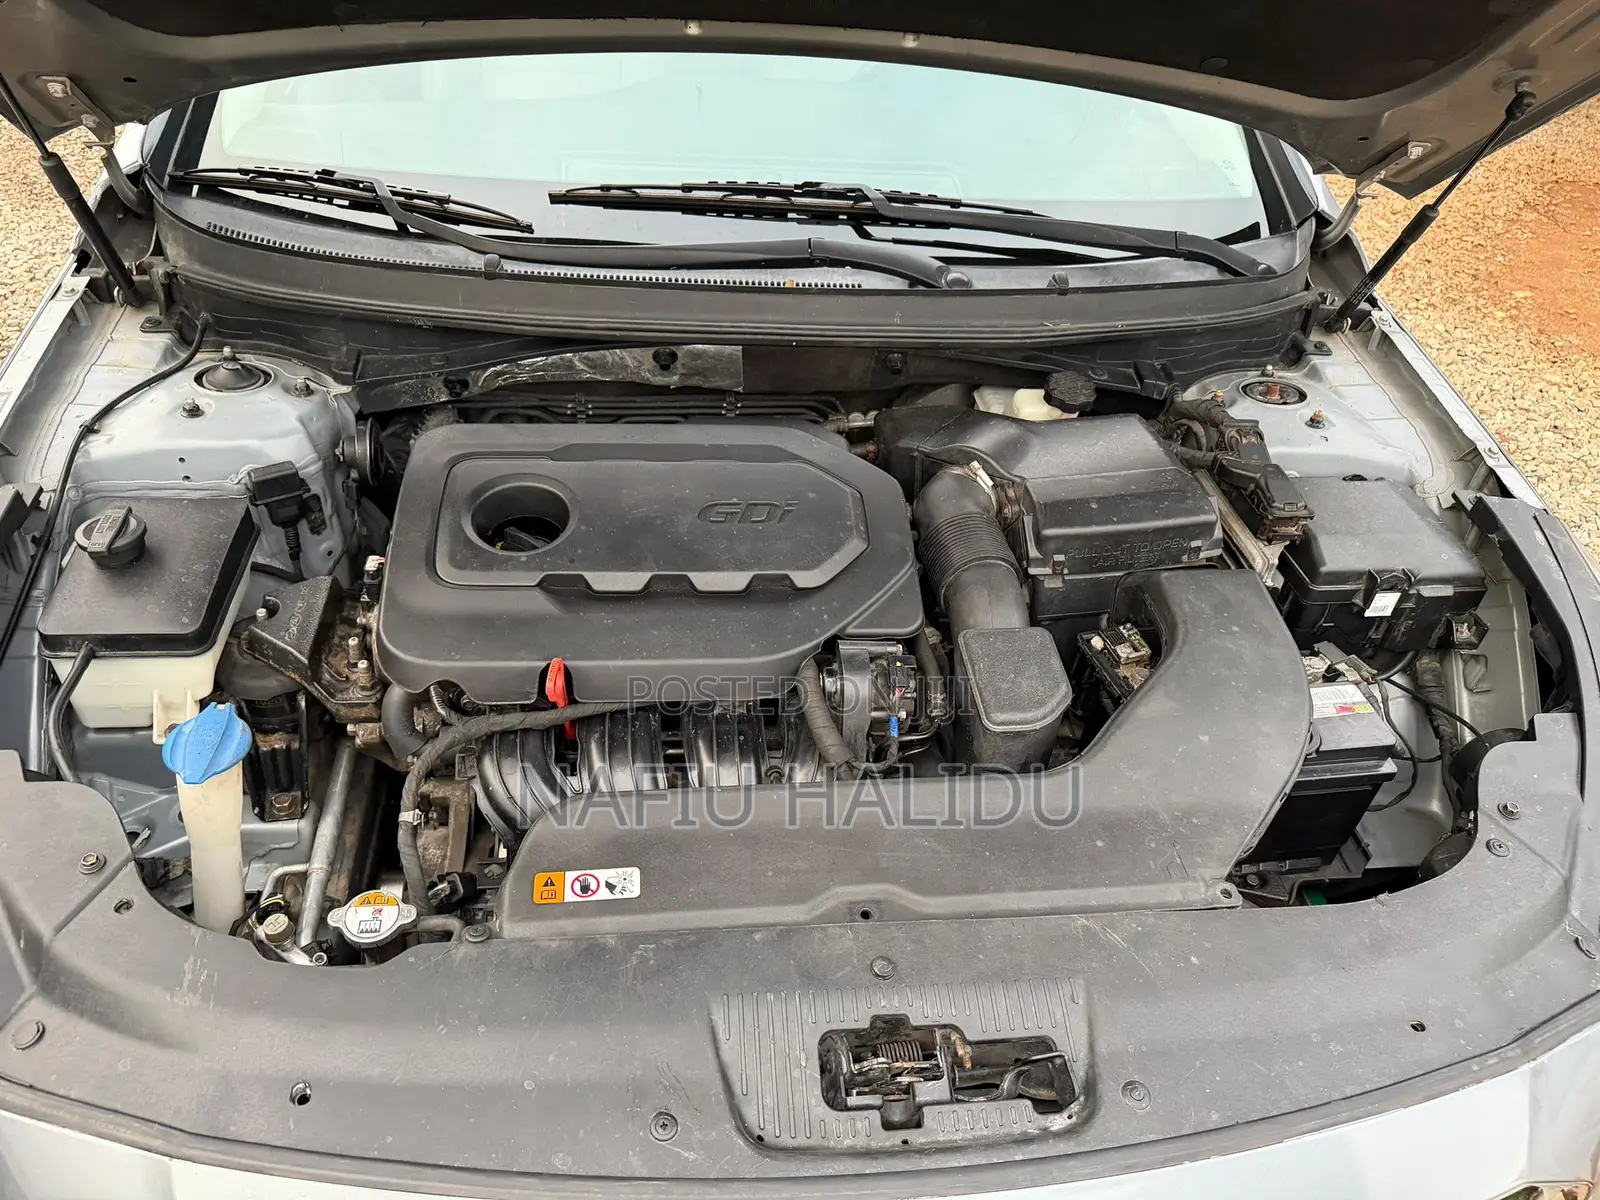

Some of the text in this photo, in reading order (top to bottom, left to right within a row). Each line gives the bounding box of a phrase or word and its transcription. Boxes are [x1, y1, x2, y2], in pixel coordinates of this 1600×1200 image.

[1066, 537, 1189, 560] PULL OUT TO OPEN
